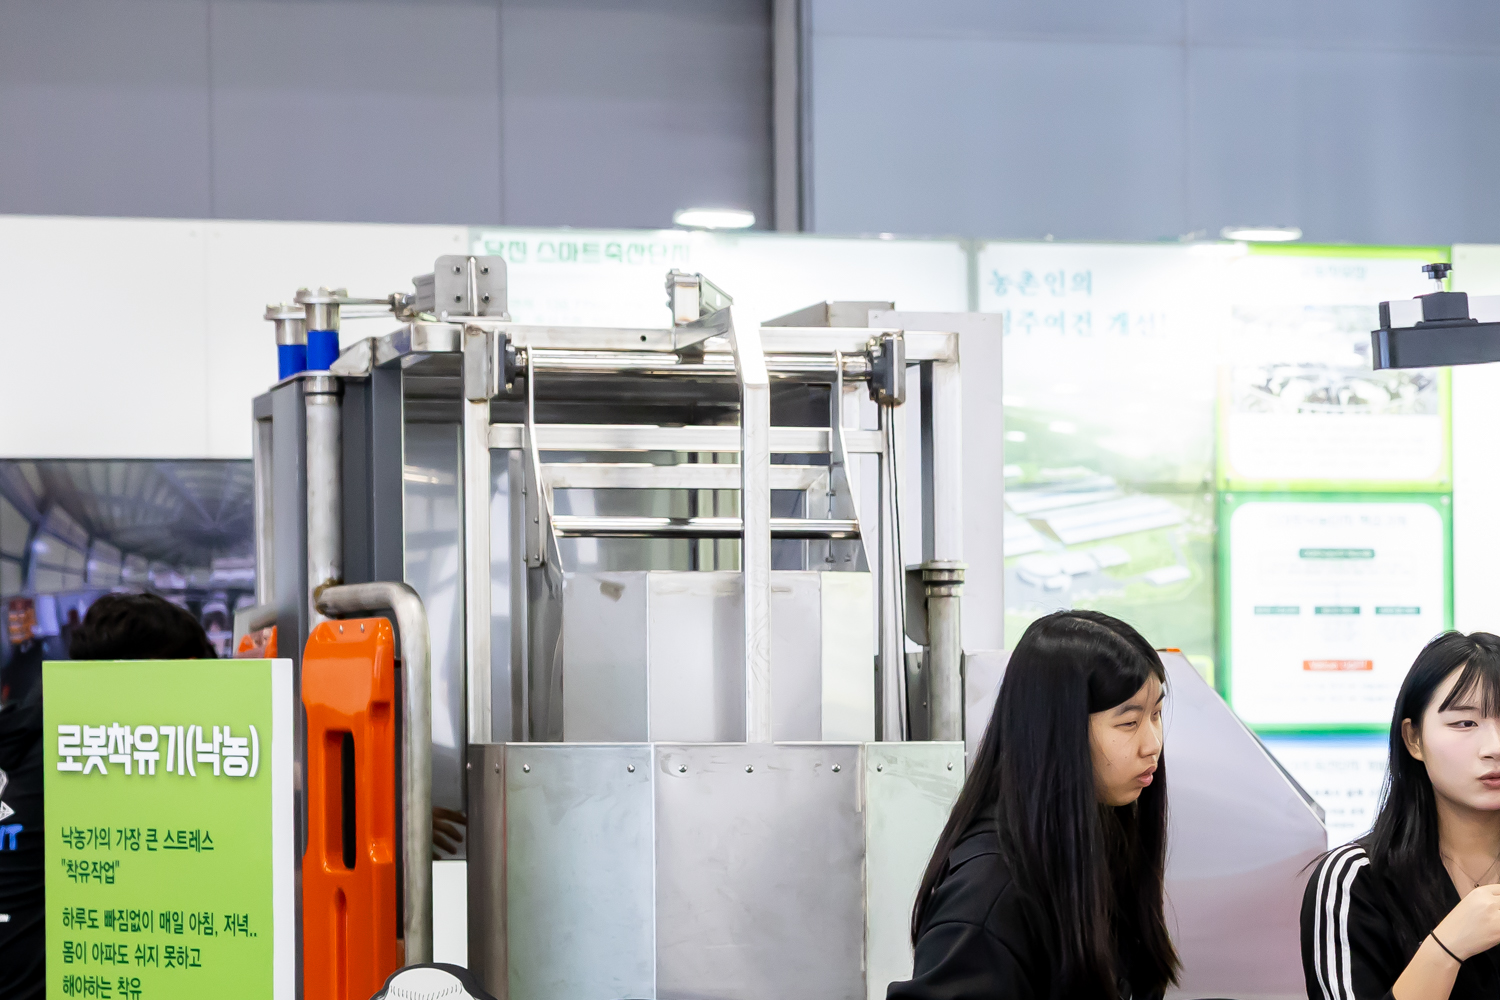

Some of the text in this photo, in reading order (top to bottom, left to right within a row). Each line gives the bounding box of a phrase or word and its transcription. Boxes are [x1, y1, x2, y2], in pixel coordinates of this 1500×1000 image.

[988, 267, 1094, 298] 농촌인의
[56, 722, 260, 778] 로봇착유기(낙농)
[61, 826, 215, 853] 낙농가의 가장 큰 스트레스
[61, 858, 120, 885] "착유작업"
[62, 906, 258, 938] 하루도 빠짐없이 매일 아침, 저녁..
[62, 940, 202, 970] 몸이 아파도 쉬지 못하고
[62, 974, 143, 1000] 해야하는 착유
